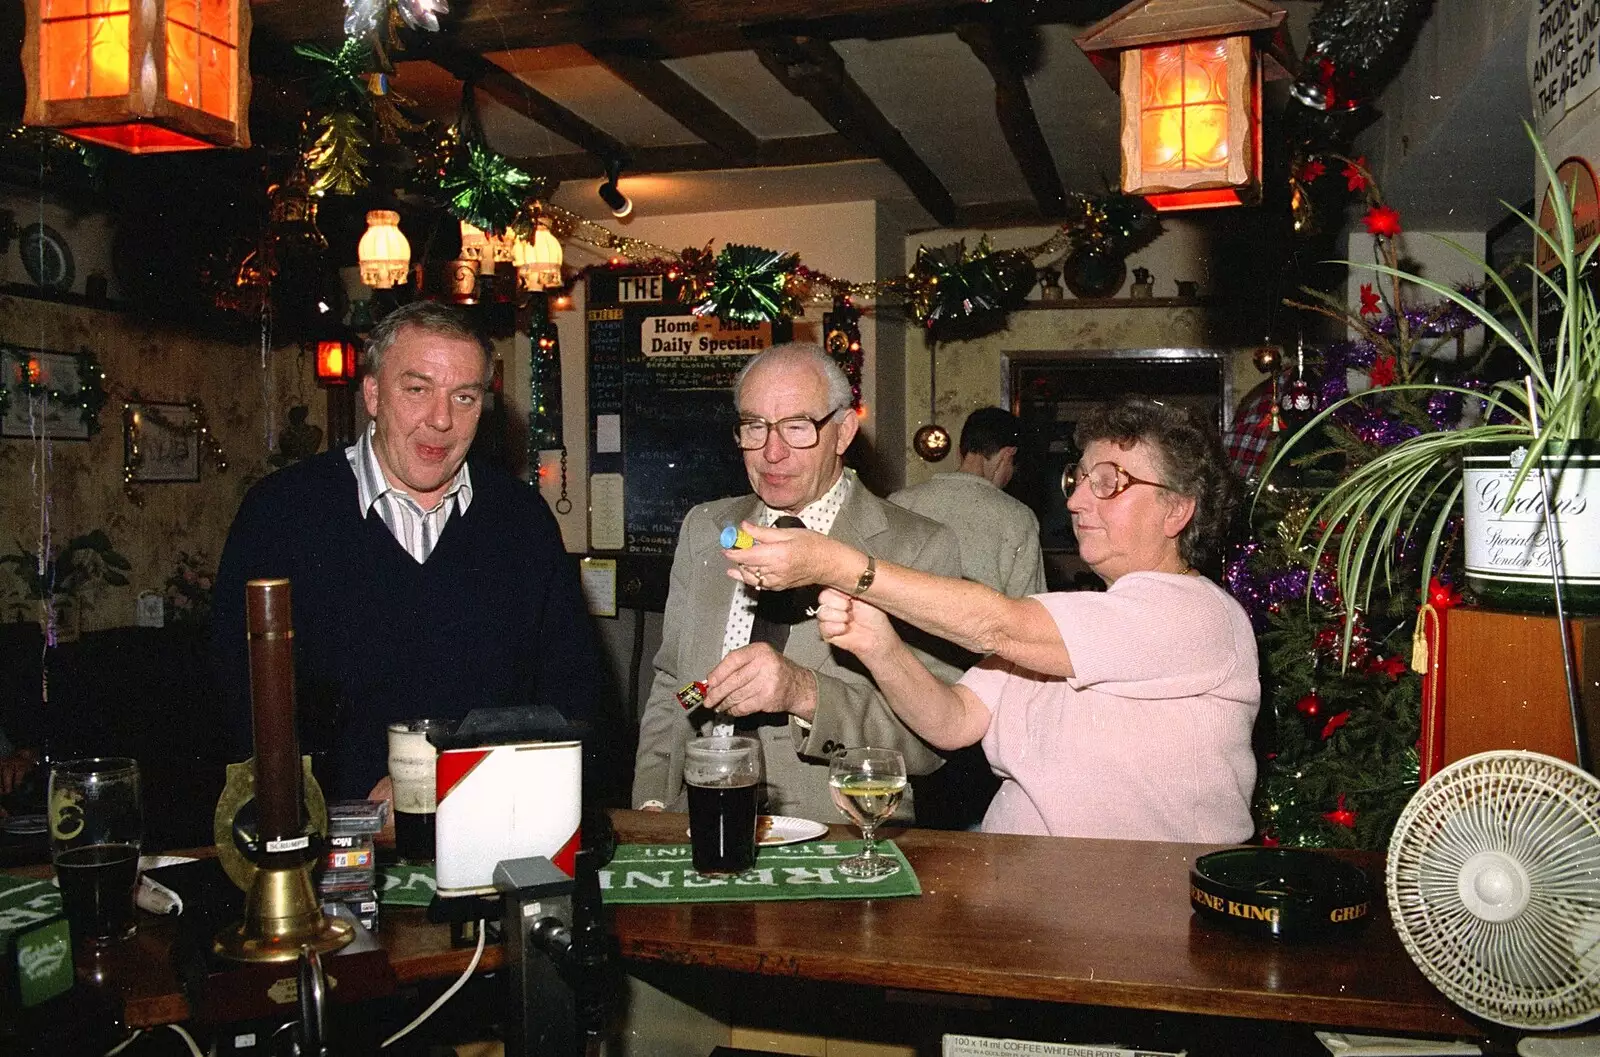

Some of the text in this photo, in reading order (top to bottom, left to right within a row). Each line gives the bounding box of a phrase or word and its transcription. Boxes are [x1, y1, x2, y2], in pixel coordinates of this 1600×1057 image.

[1538, 79, 1558, 116] THE
[1580, 40, 1595, 79] OF
[620, 277, 661, 300] THE
[654, 319, 699, 333] Home
[651, 336, 764, 354] Daily Specials
[1475, 478, 1587, 515] Godon's
[1486, 527, 1536, 547] Special
[1487, 548, 1533, 568] London
[1228, 901, 1280, 922] KING
[954, 1037, 970, 1047] 100
[1003, 1042, 1042, 1054] COFFEE
[1043, 1046, 1093, 1057] WHITENER
